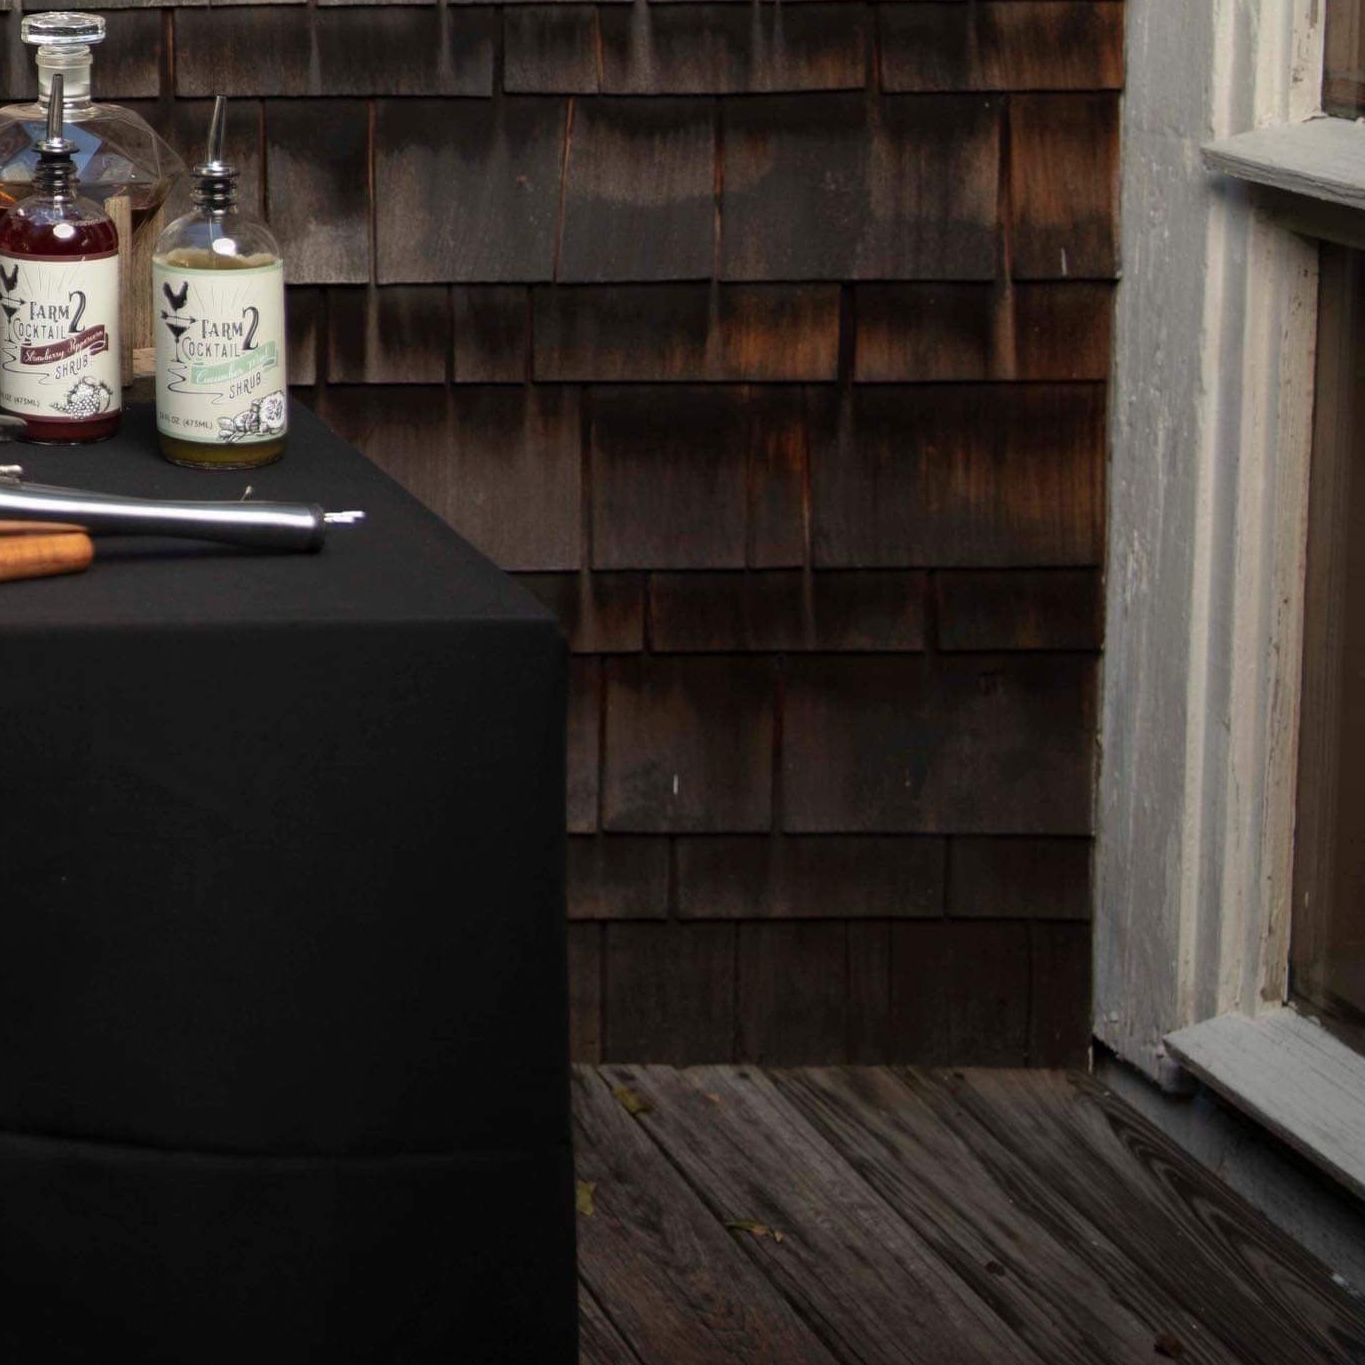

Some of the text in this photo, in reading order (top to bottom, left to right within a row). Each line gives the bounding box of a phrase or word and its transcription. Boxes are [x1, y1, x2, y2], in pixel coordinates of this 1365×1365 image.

[12, 318, 66, 340] COCKTAIL
[24, 347, 64, 363] Strawberry
[181, 336, 241, 360] COCKTAIL
[55, 354, 89, 379] SHRUB
[229, 371, 261, 399] SHRUB
